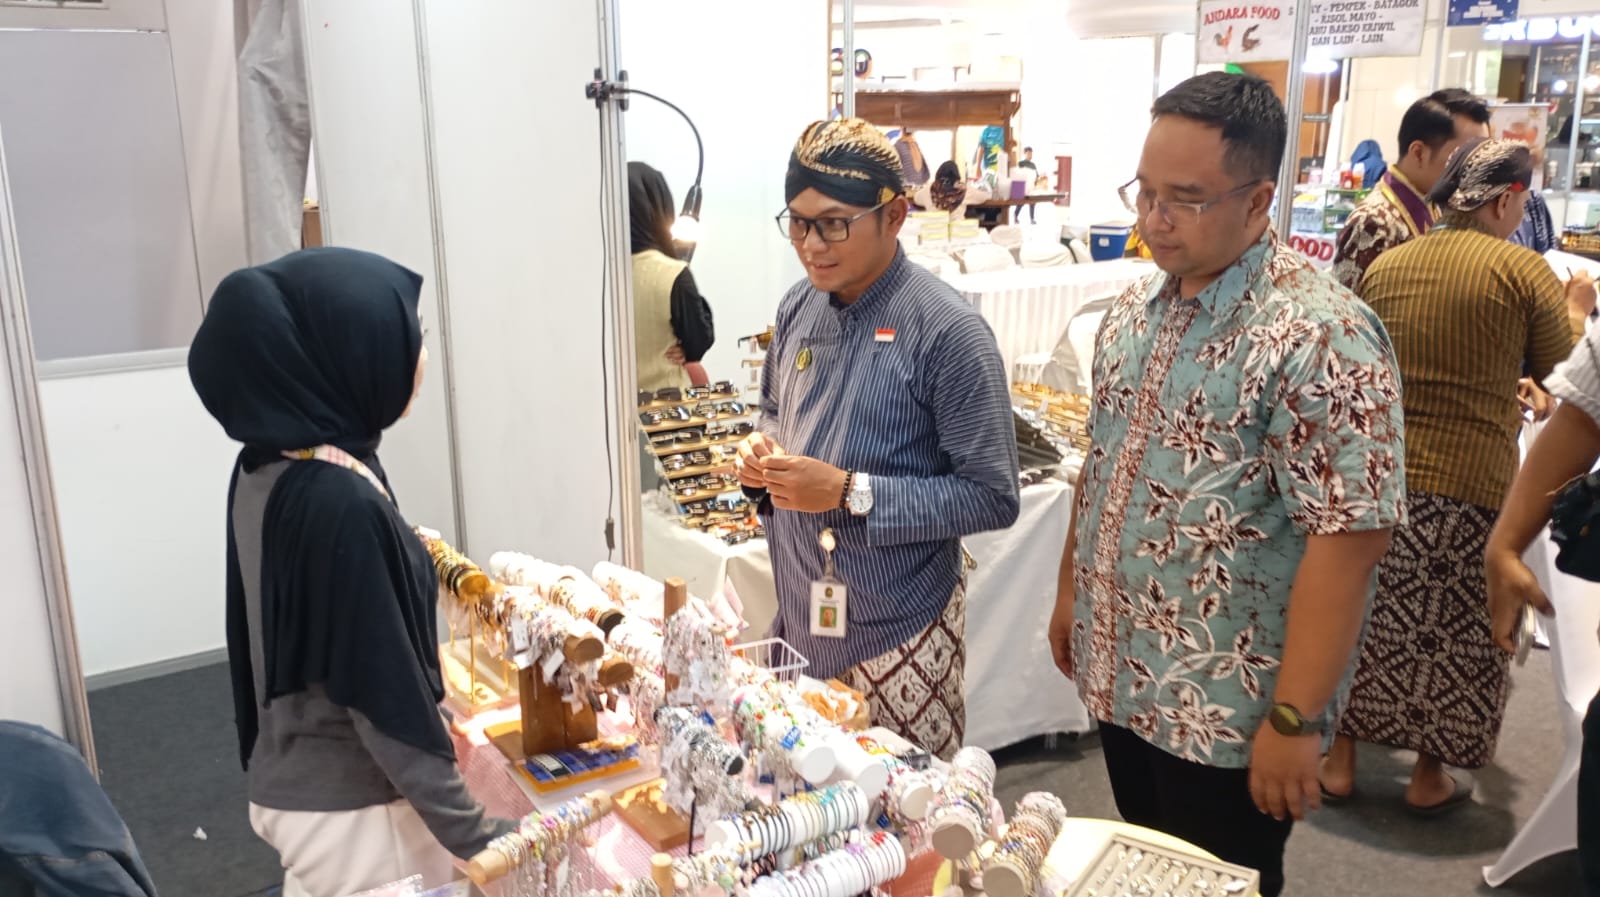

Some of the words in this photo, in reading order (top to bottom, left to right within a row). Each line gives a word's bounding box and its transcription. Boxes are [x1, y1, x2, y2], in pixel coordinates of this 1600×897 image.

[1330, 2, 1366, 12] PEMPEK
[1204, 7, 1247, 25] ANDARA
[1251, 7, 1280, 20] FOOD
[1321, 14, 1346, 24] RISOL
[1349, 11, 1377, 22] MAYO
[1309, 26, 1327, 35] AHU
[1329, 23, 1360, 34] BAKSO
[1289, 236, 1333, 261] OOD
